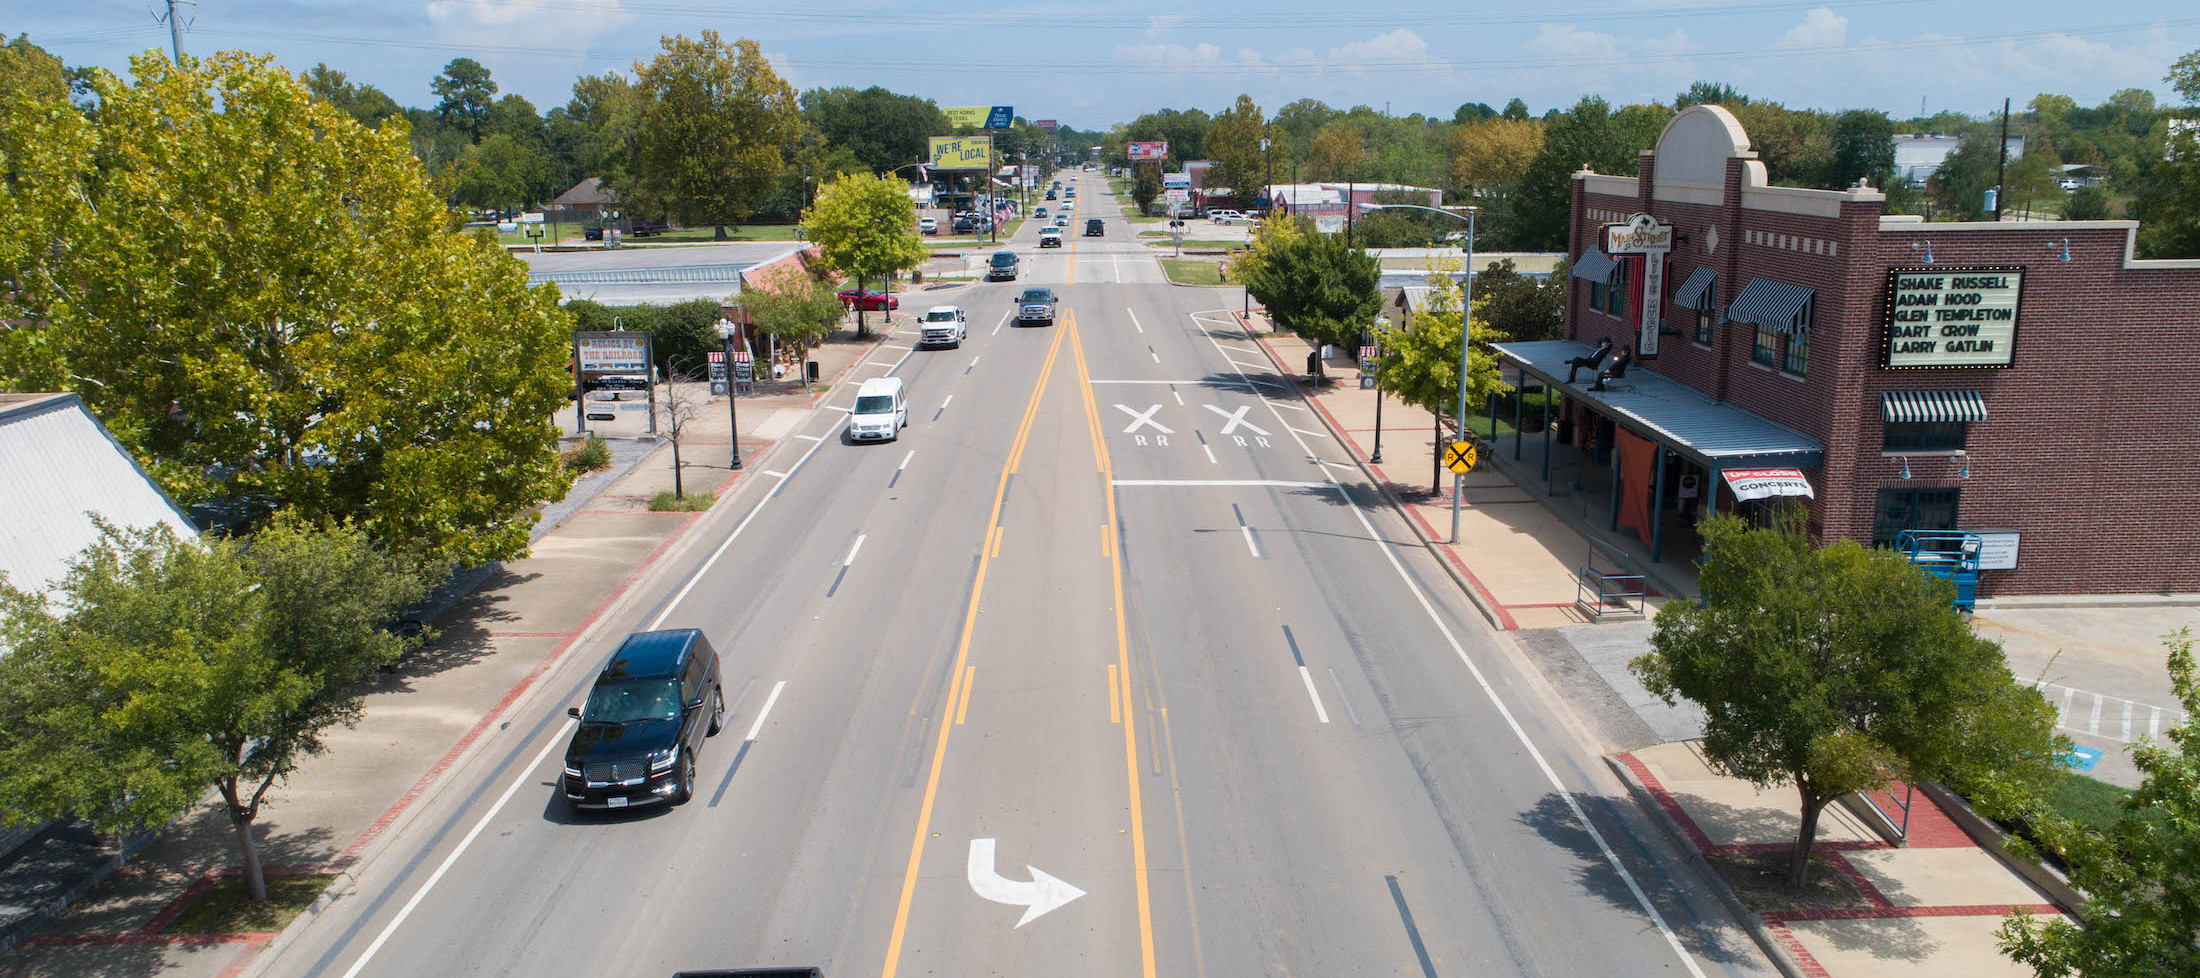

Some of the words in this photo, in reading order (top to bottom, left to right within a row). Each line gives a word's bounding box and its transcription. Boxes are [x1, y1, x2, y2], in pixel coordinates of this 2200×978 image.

[936, 141, 962, 154] WE'RE
[960, 148, 985, 161] LOCAL
[1648, 253, 1659, 295] LIVE
[1899, 278, 1944, 290] SHAKE
[1951, 277, 2009, 289] RUSSELL
[1897, 294, 1938, 306] ADAM
[1945, 293, 1982, 305] HOOD
[1895, 310, 1929, 322] GLEN
[1936, 309, 2012, 321] TEMPLETON
[1644, 299, 1658, 352] MUSIC
[1892, 325, 1932, 338] BART
[1941, 325, 1980, 337] CROW
[592, 340, 621, 349] RELICS
[624, 340, 634, 349] BY
[1893, 341, 1937, 353] LARRY
[1945, 340, 1994, 352] GATLIN
[584, 351, 600, 360] THE
[603, 351, 643, 360] RAILROAD
[1740, 482, 1807, 491] CONCERTS
